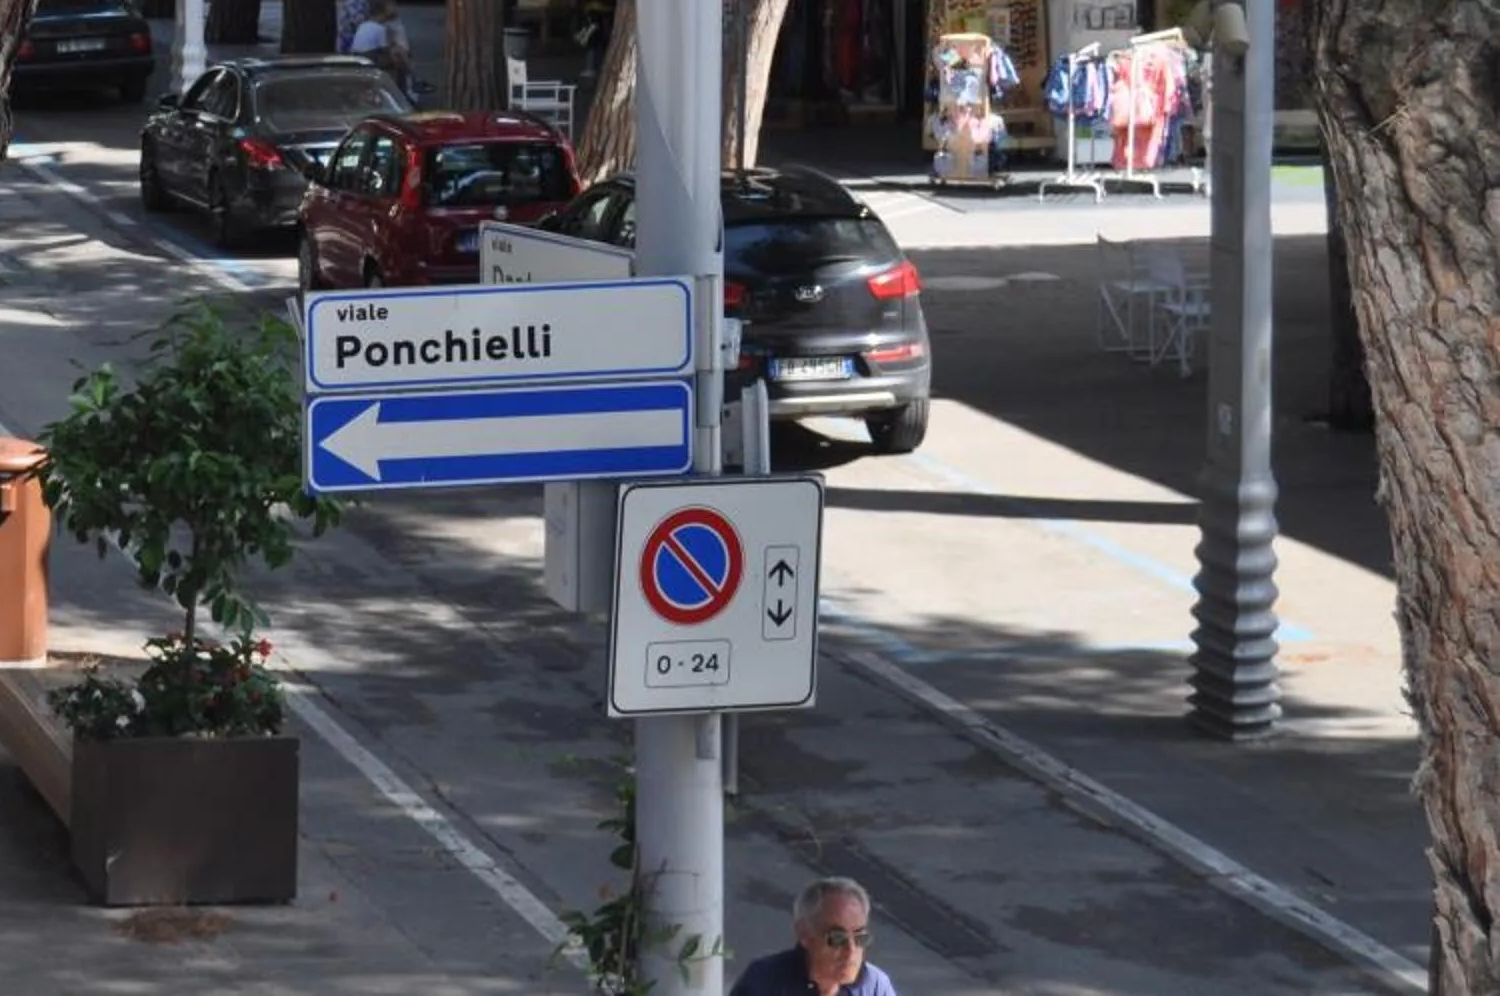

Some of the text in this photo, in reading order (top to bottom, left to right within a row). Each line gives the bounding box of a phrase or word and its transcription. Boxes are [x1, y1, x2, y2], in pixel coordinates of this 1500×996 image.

[336, 304, 389, 322] viale
[336, 324, 551, 368] Ponchielli
[657, 655, 671, 675] 0
[691, 653, 719, 672] 24
